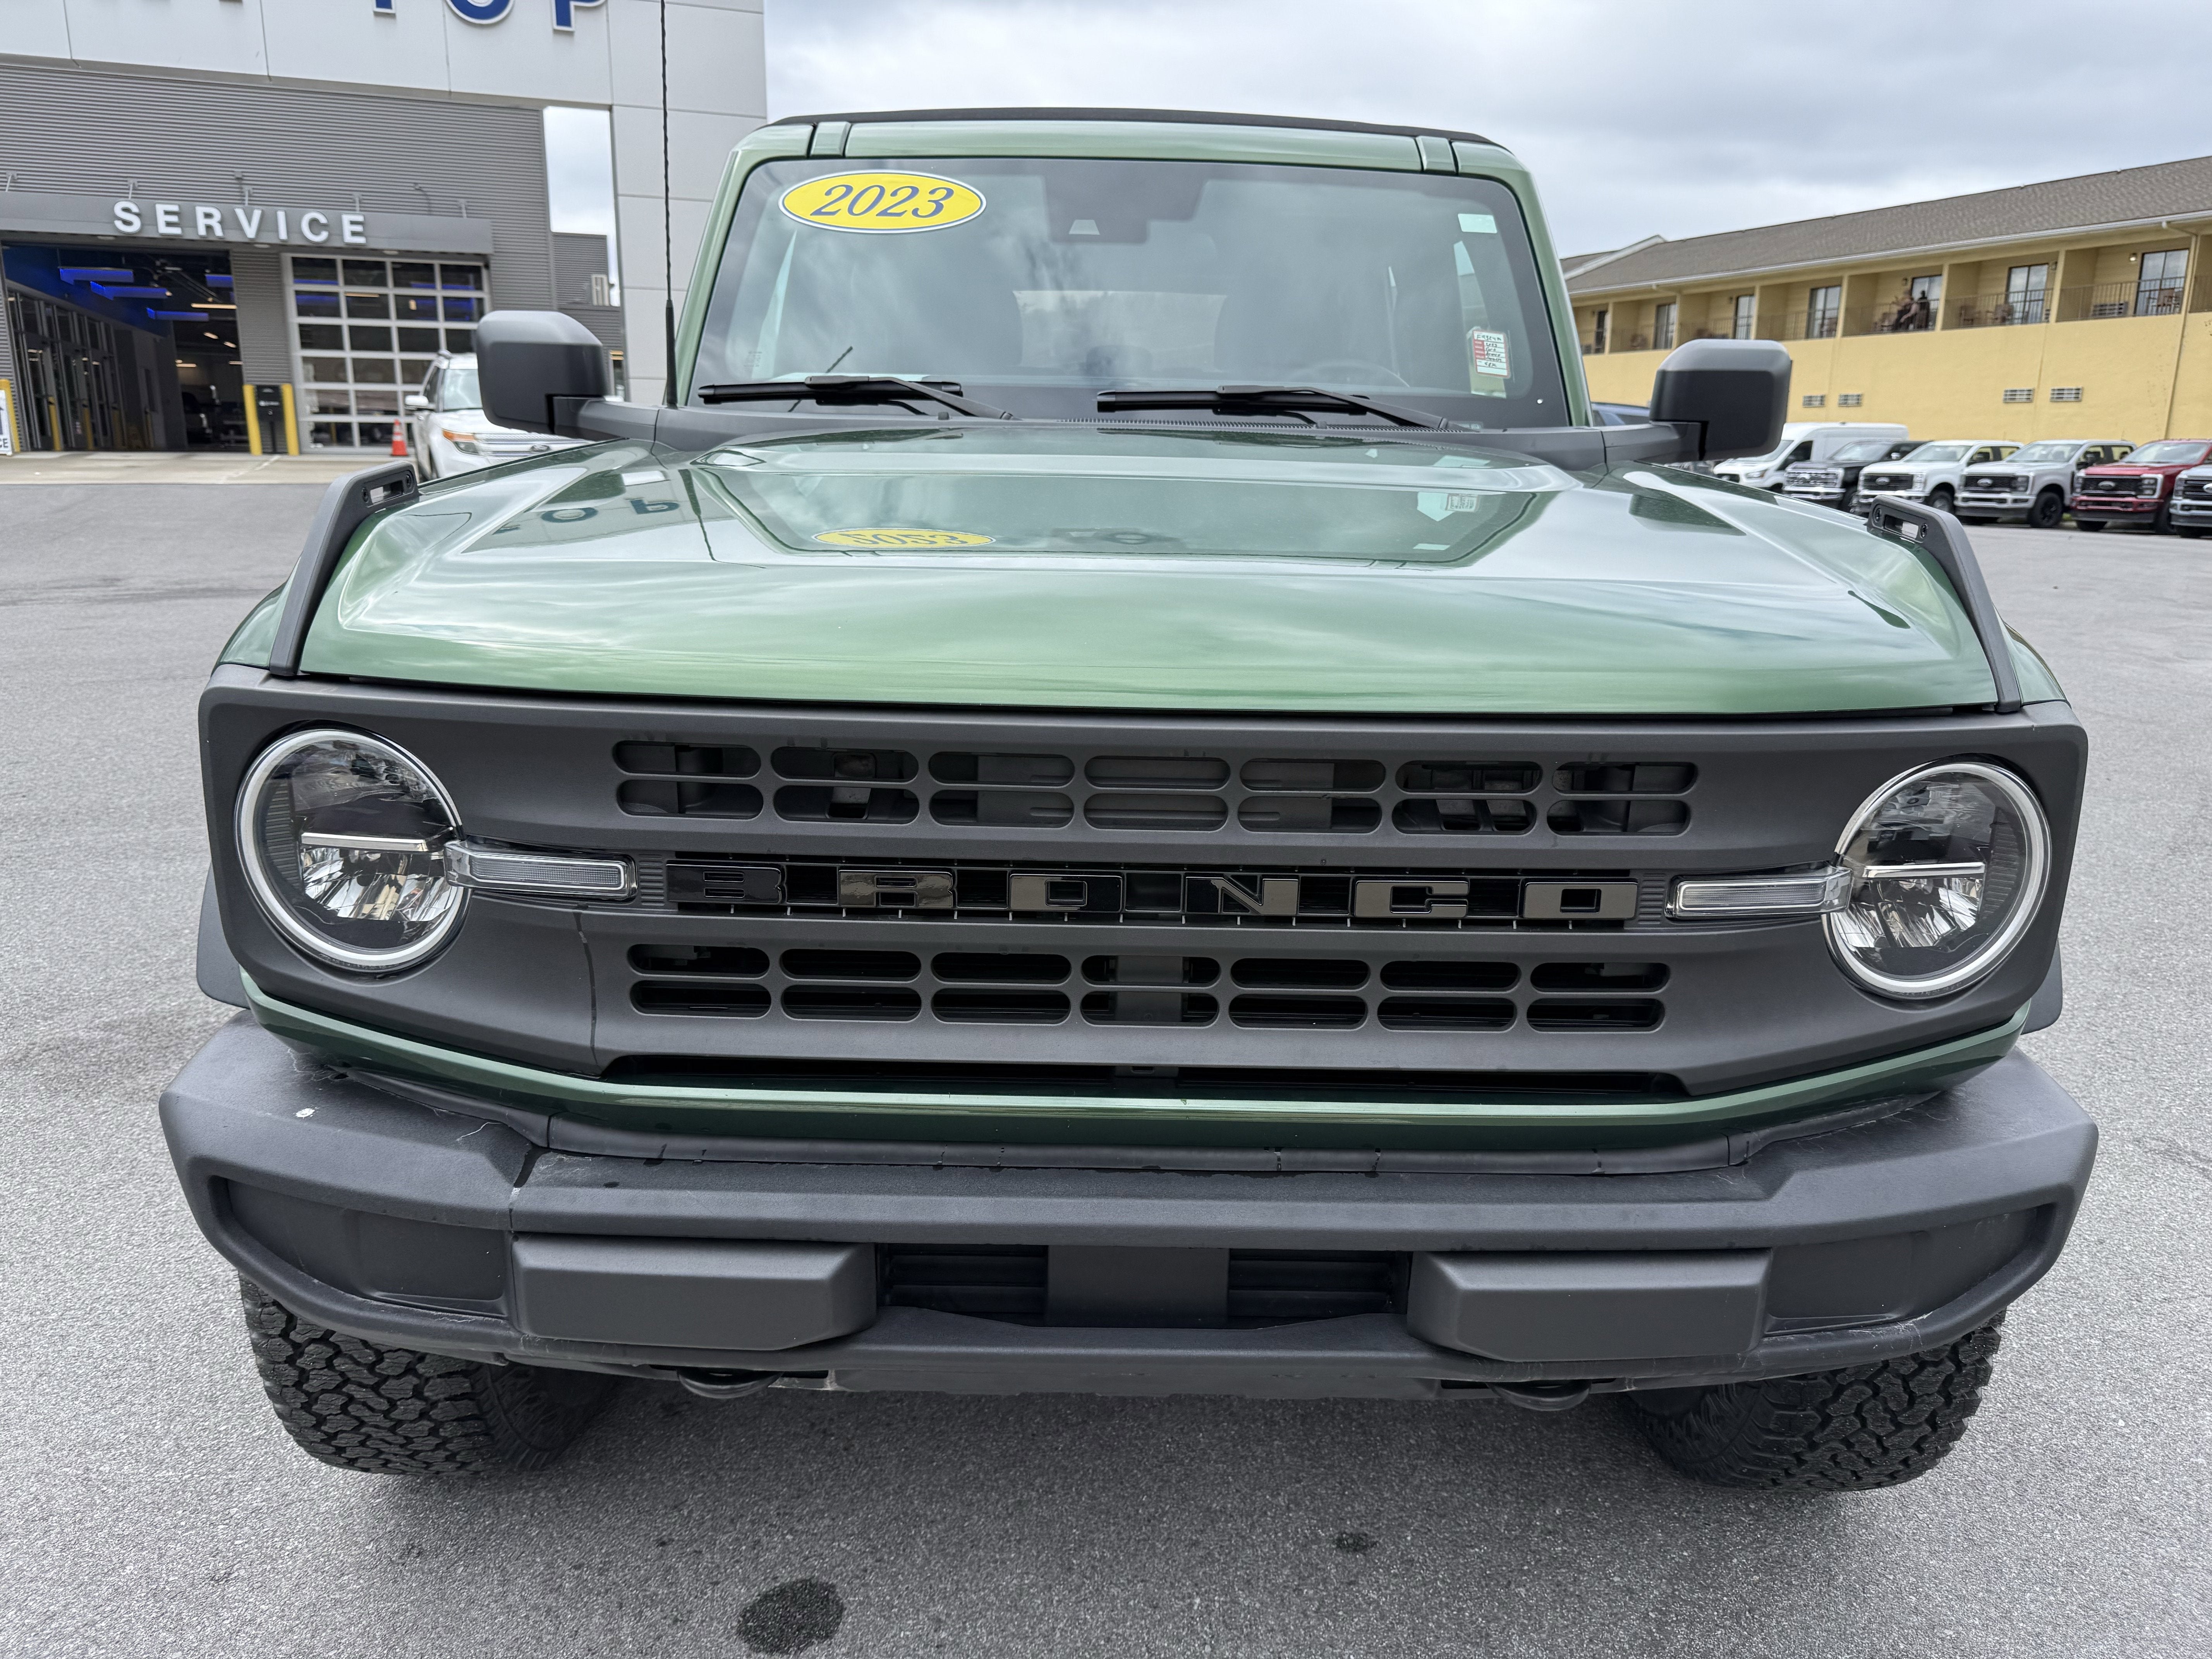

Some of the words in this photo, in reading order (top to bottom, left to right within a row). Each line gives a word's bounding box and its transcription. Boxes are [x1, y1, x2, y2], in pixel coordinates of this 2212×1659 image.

[113, 199, 367, 245] SERVICE
[810, 184, 954, 218] 2023
[666, 864, 1639, 919] BRONCO
